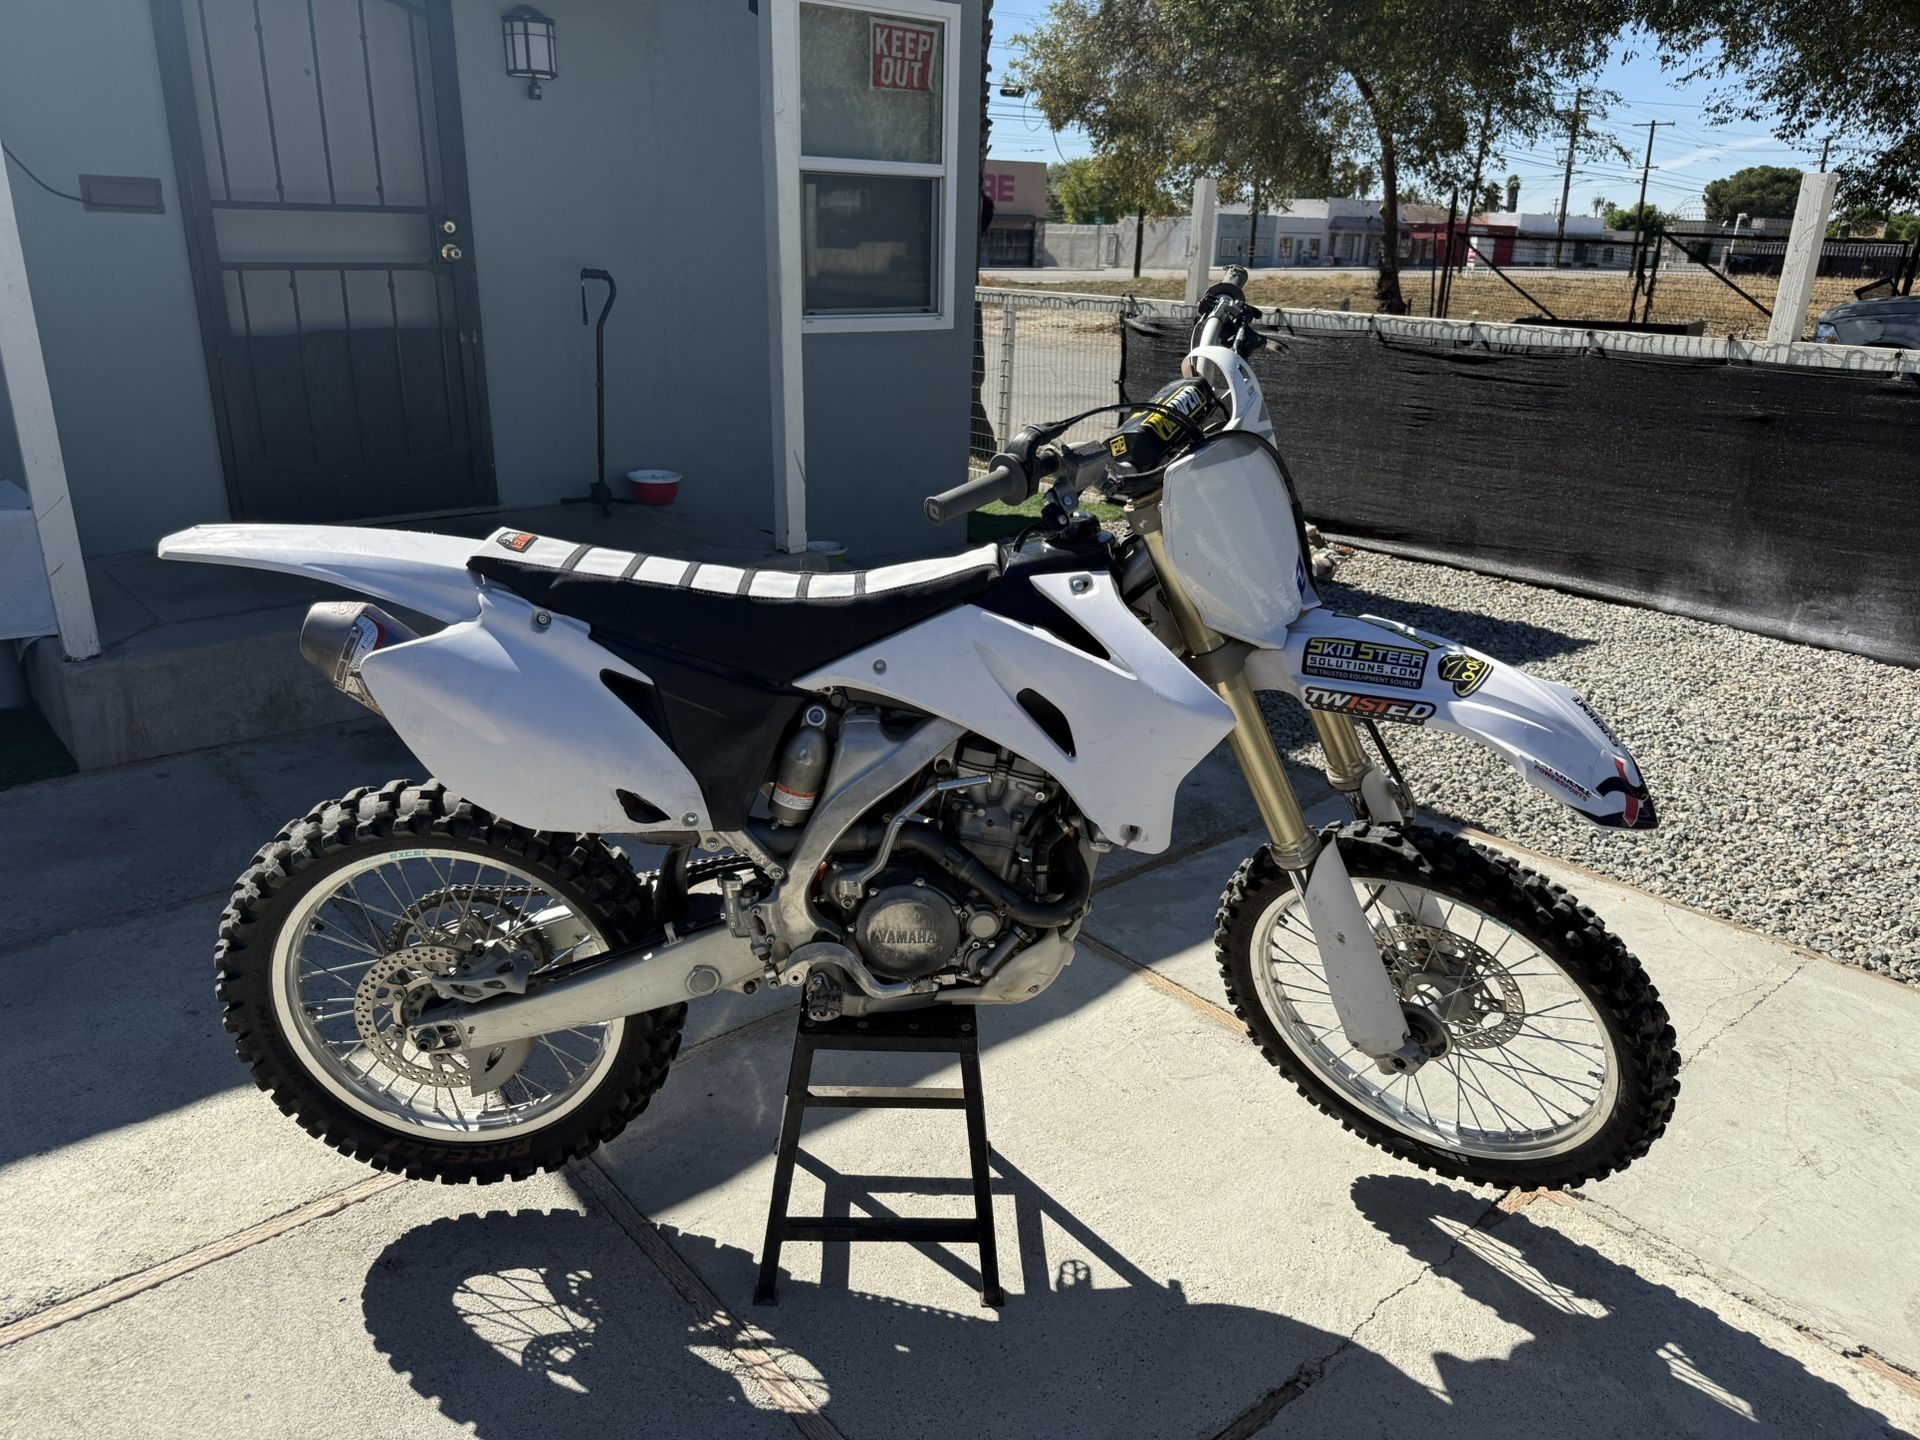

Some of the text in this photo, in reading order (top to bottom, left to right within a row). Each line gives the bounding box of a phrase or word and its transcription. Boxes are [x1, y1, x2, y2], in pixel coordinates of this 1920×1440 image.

[875, 28, 931, 61] KEEP
[881, 56, 923, 88] OUT
[1308, 639, 1427, 669] SKID STEER
[1309, 656, 1419, 678] SOLUTIONS.COM
[1306, 667, 1319, 675] THE
[1320, 669, 1348, 679] TRUSTED
[1349, 673, 1389, 684] EQUIPMENT
[1307, 689, 1434, 719] TWISTED
[1313, 702, 1423, 724] DEVELOPMENT
[878, 929, 937, 945] YAMAHA
